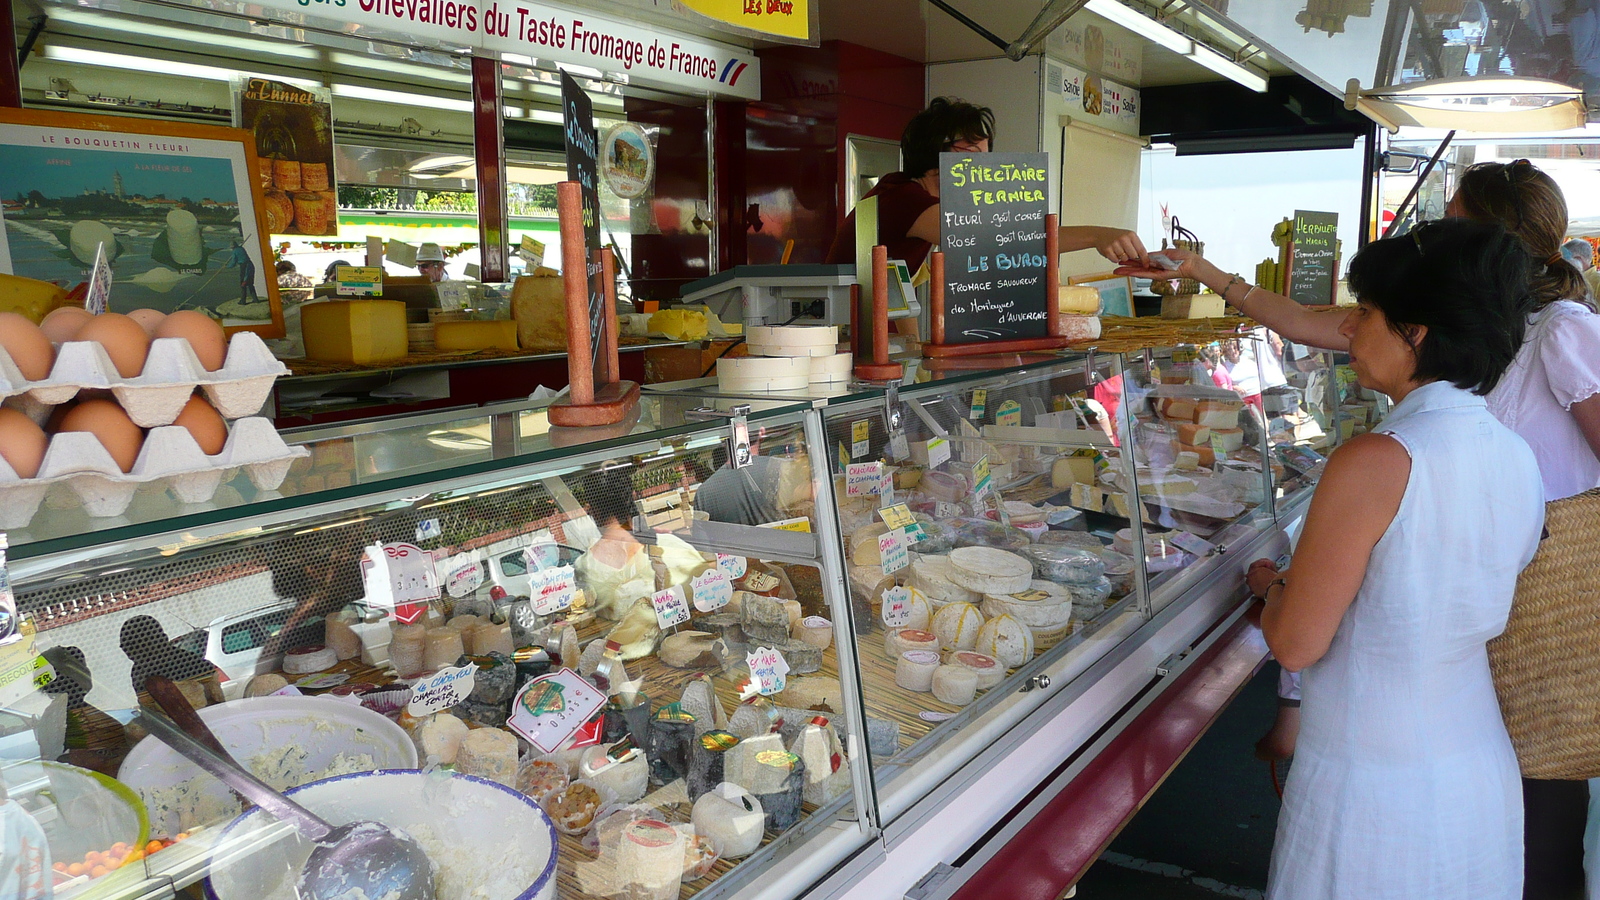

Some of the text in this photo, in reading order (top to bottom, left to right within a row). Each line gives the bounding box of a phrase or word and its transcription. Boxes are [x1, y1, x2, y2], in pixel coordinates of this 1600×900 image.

[484, 3, 510, 38] du
[517, 7, 566, 49] Taste
[571, 20, 643, 70] Fromage
[647, 39, 665, 69] de
[669, 43, 717, 80] France
[1063, 79, 1080, 96] Savoie
[1122, 98, 1136, 114] Savoie
[42, 135, 189, 152] LE BOUQUETIN FLEURI
[970, 186, 1045, 206] FERMIER
[945, 210, 982, 227] FLEURI
[967, 255, 989, 273] LE
[949, 282, 991, 295] FROMAGE
[951, 304, 965, 314] des
[0, 661, 39, 686] RECQUE
